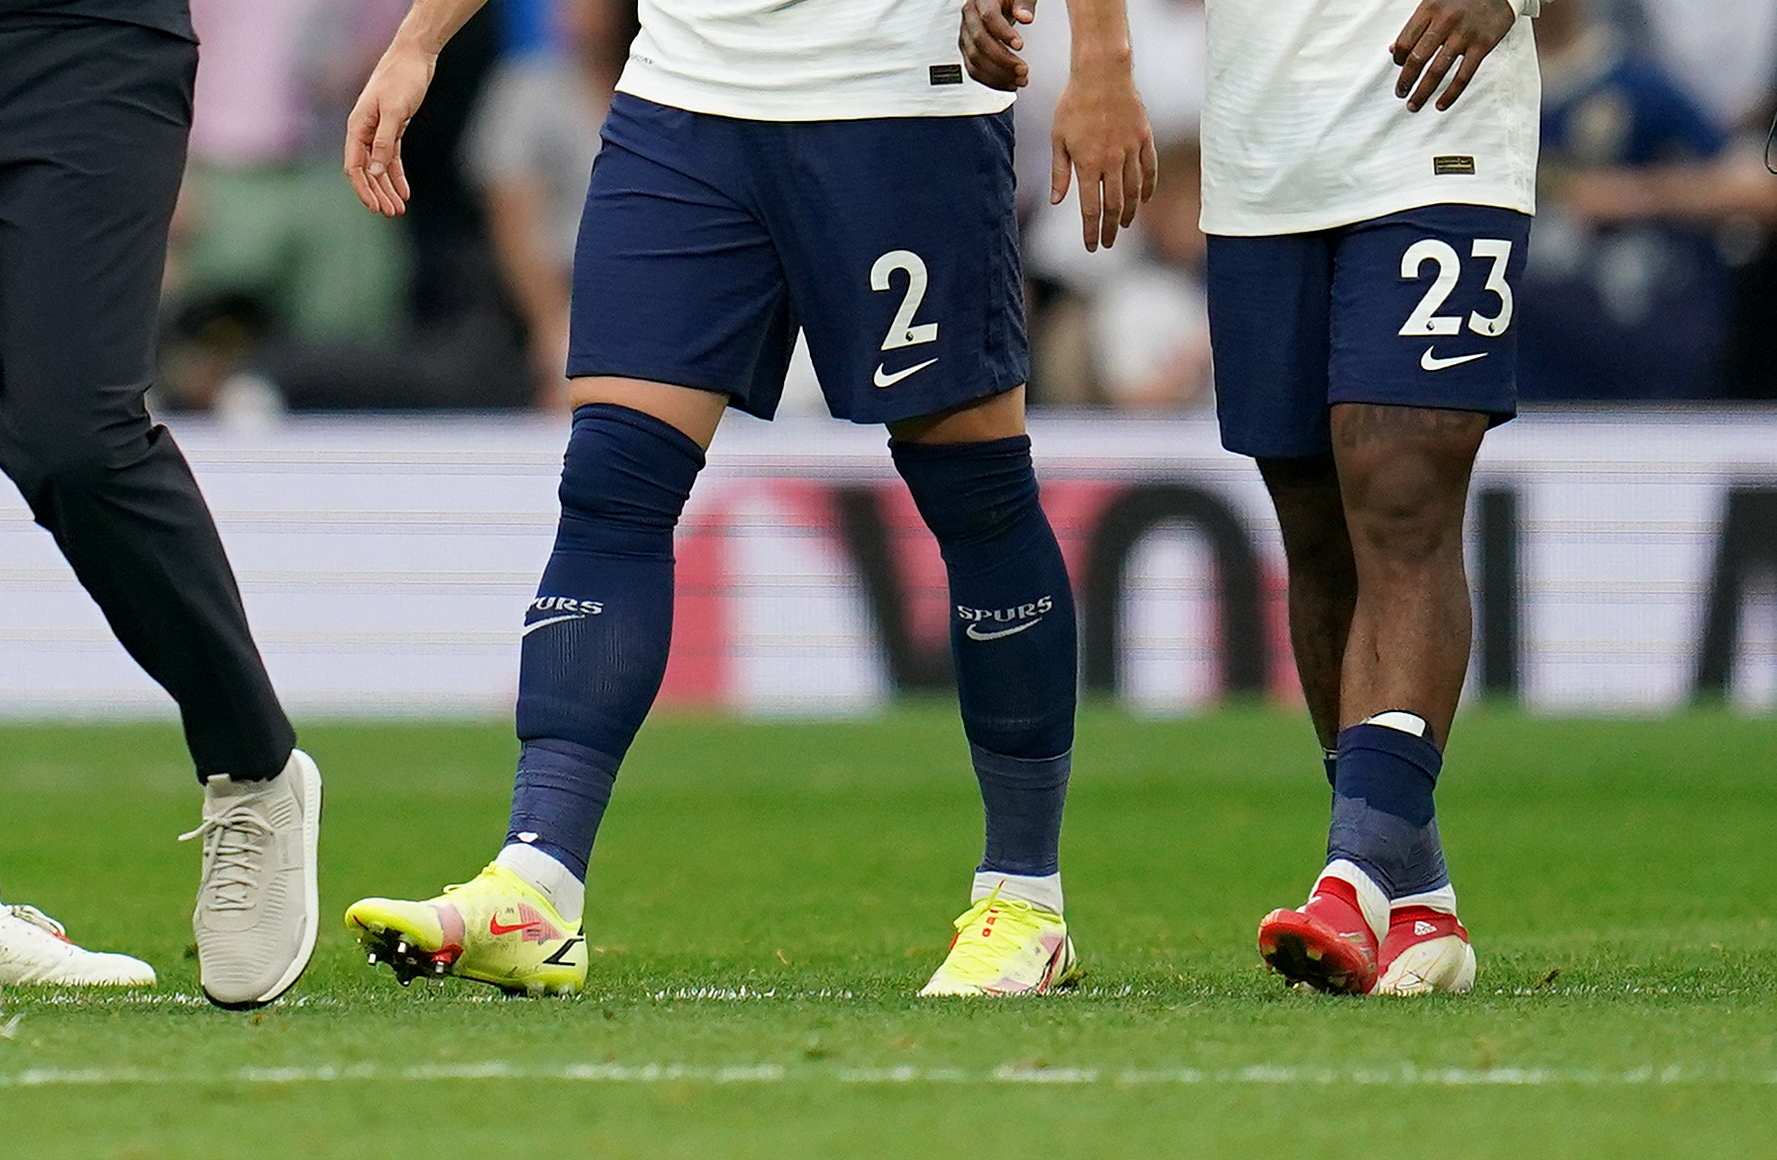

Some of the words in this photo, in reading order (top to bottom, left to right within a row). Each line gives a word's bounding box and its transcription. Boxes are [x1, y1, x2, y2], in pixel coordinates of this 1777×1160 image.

[870, 249, 939, 351] 2
[1398, 238, 1514, 337] 23
[957, 595, 1053, 622] SPURS
